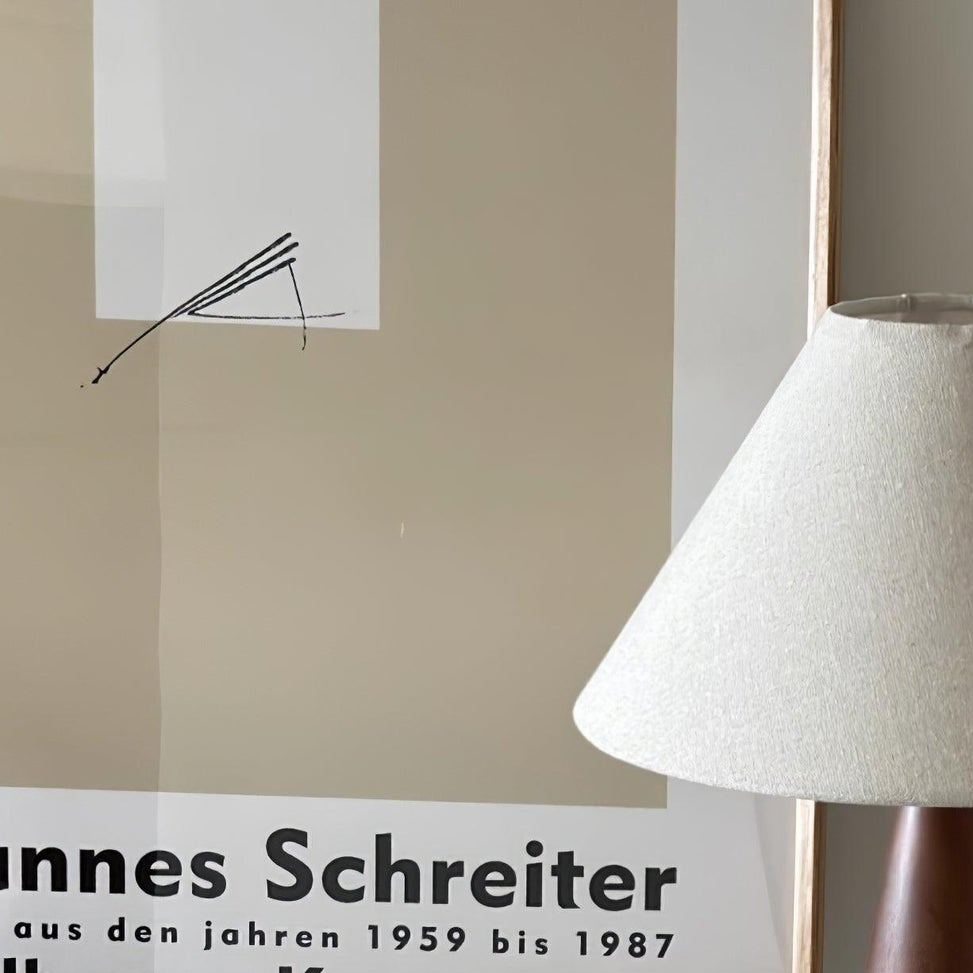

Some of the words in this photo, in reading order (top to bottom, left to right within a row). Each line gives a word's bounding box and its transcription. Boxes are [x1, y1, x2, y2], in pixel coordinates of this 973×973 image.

[265, 827, 678, 912] Schreiter
[13, 921, 82, 941] aus
[107, 916, 178, 944] den
[203, 920, 339, 951] jahren
[367, 924, 466, 952] 1959
[492, 928, 549, 956] bis
[576, 930, 674, 959] 1987
